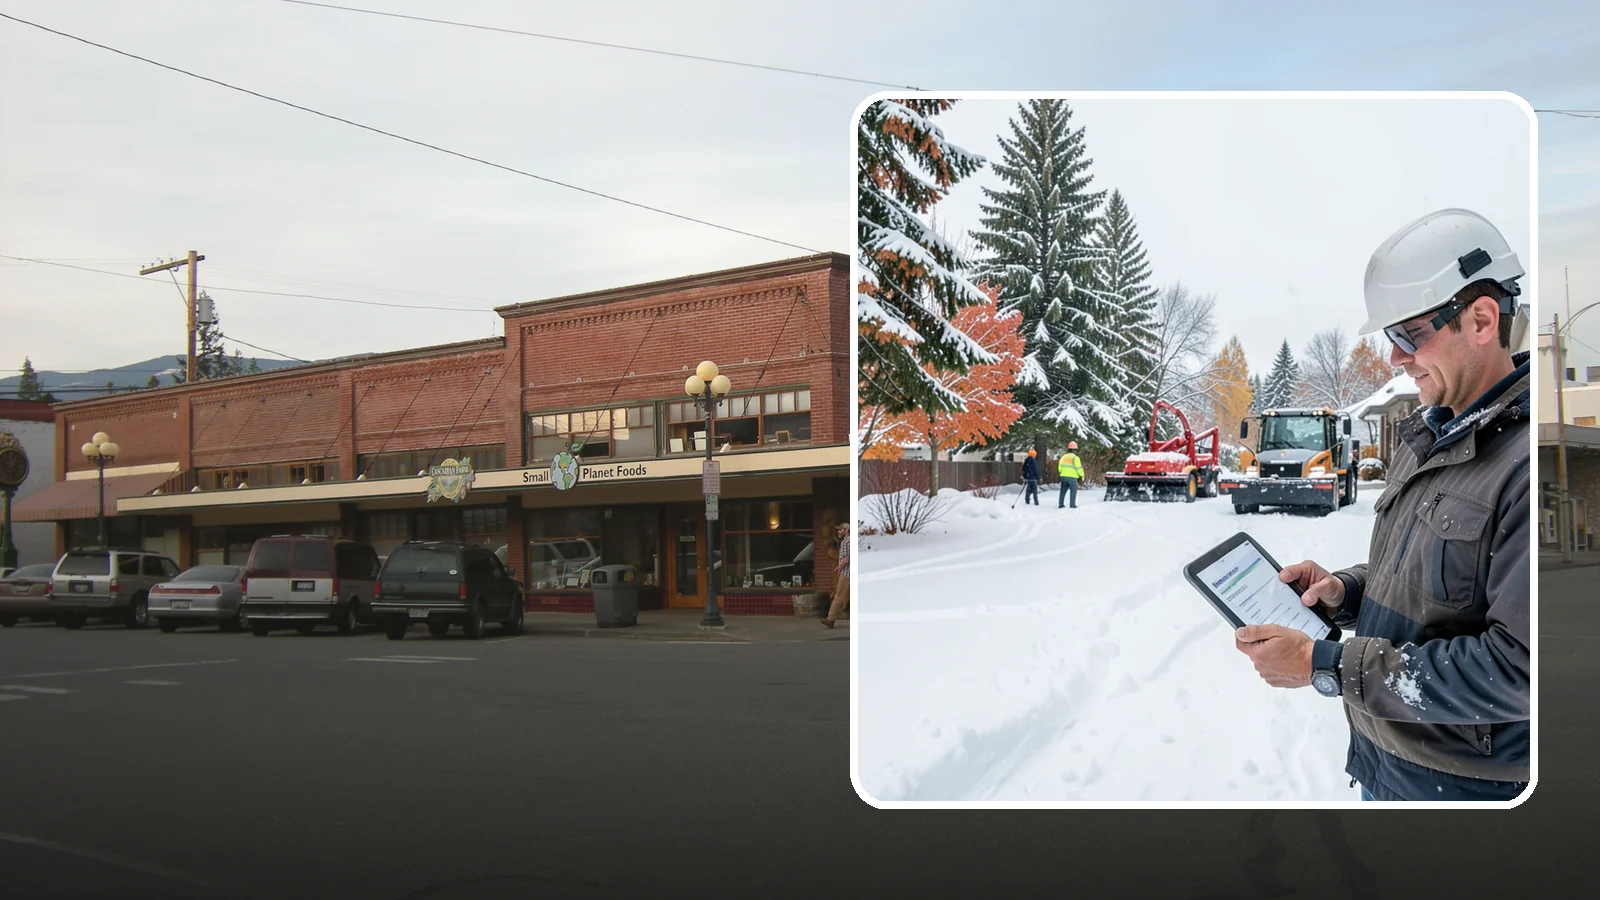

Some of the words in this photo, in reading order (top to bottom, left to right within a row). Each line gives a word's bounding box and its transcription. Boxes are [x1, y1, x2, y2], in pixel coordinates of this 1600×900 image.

[523, 471, 549, 483] Small
[582, 467, 614, 479] Planet
[617, 464, 647, 476] Foods
